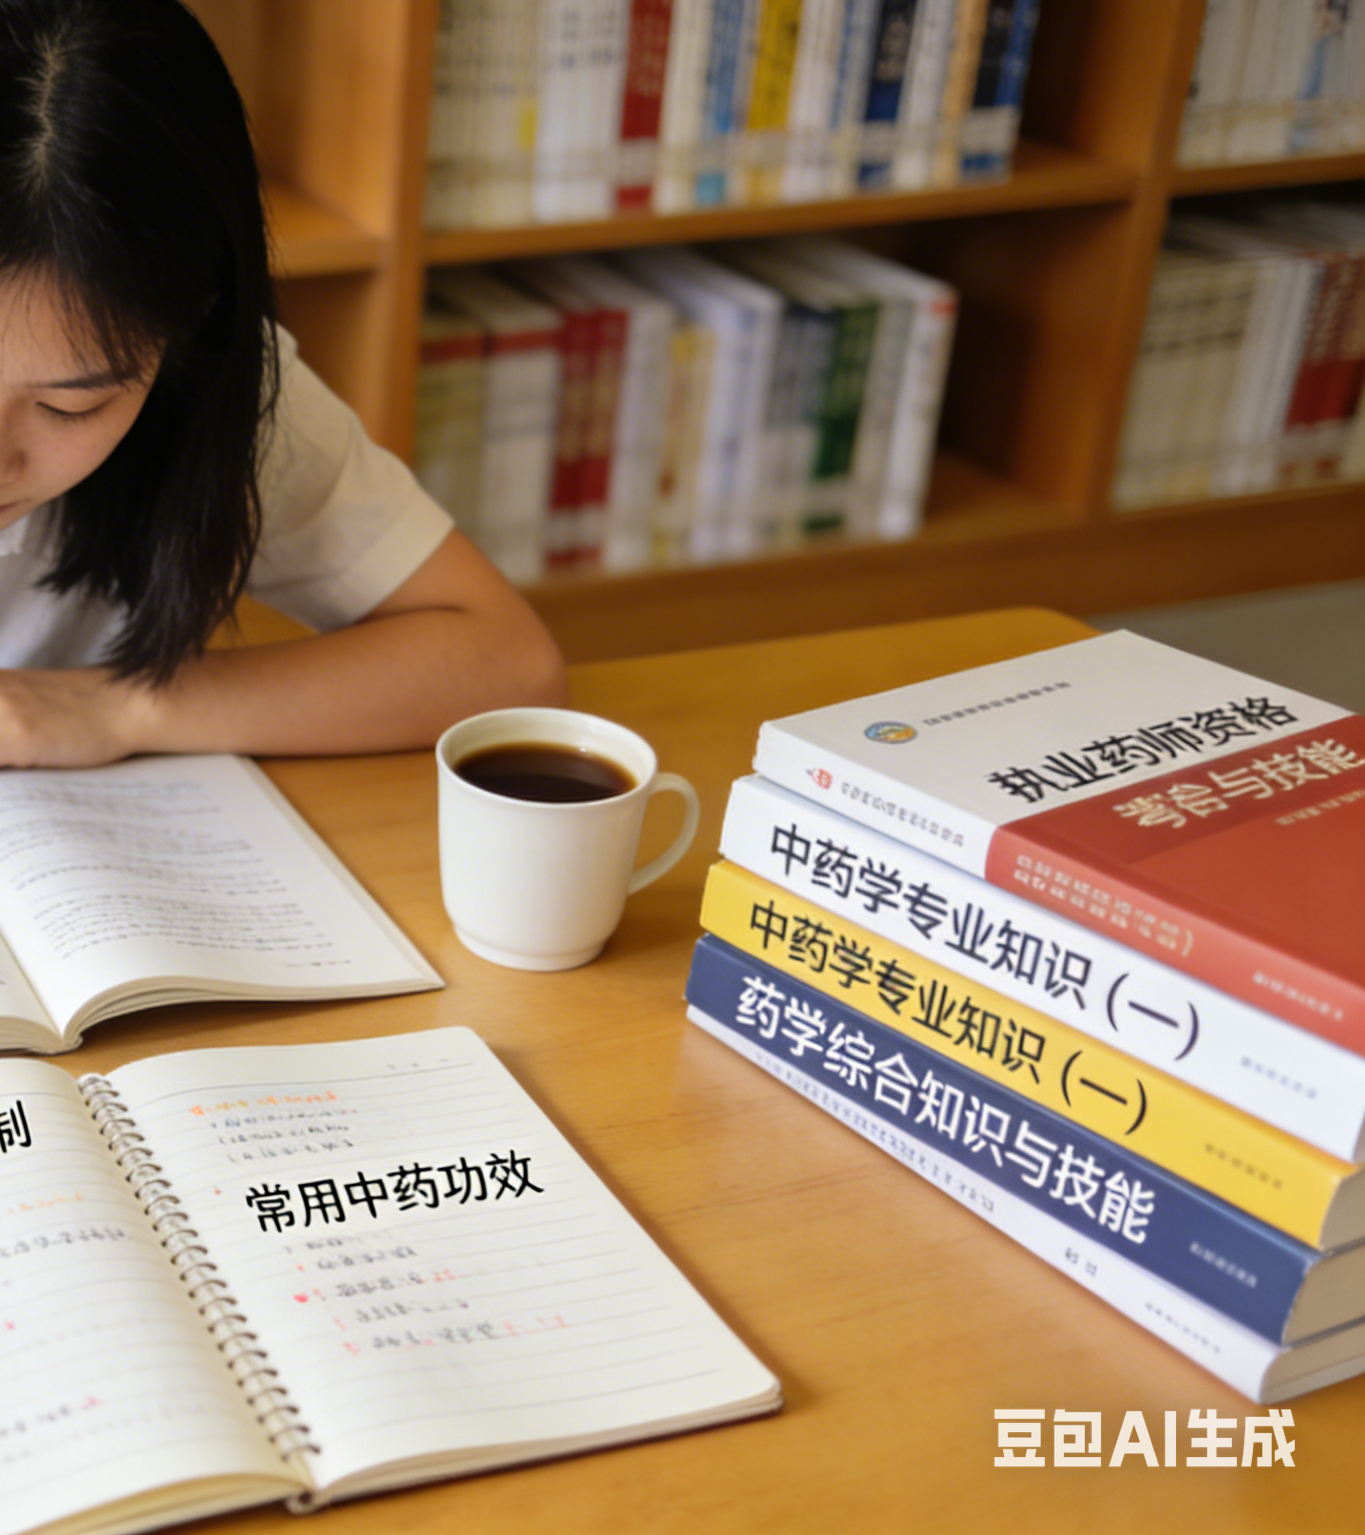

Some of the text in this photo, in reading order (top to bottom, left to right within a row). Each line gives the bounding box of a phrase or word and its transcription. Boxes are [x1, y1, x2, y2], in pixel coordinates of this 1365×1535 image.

[987, 696, 1299, 802] 执业药师资格
[749, 900, 1148, 1135] 中药学专业知识（一）
[770, 823, 1200, 1061] 中药学专业知识（一）
[245, 1149, 545, 1233] 常用中药功效
[735, 974, 1155, 1245] 药学综合知识与技能
